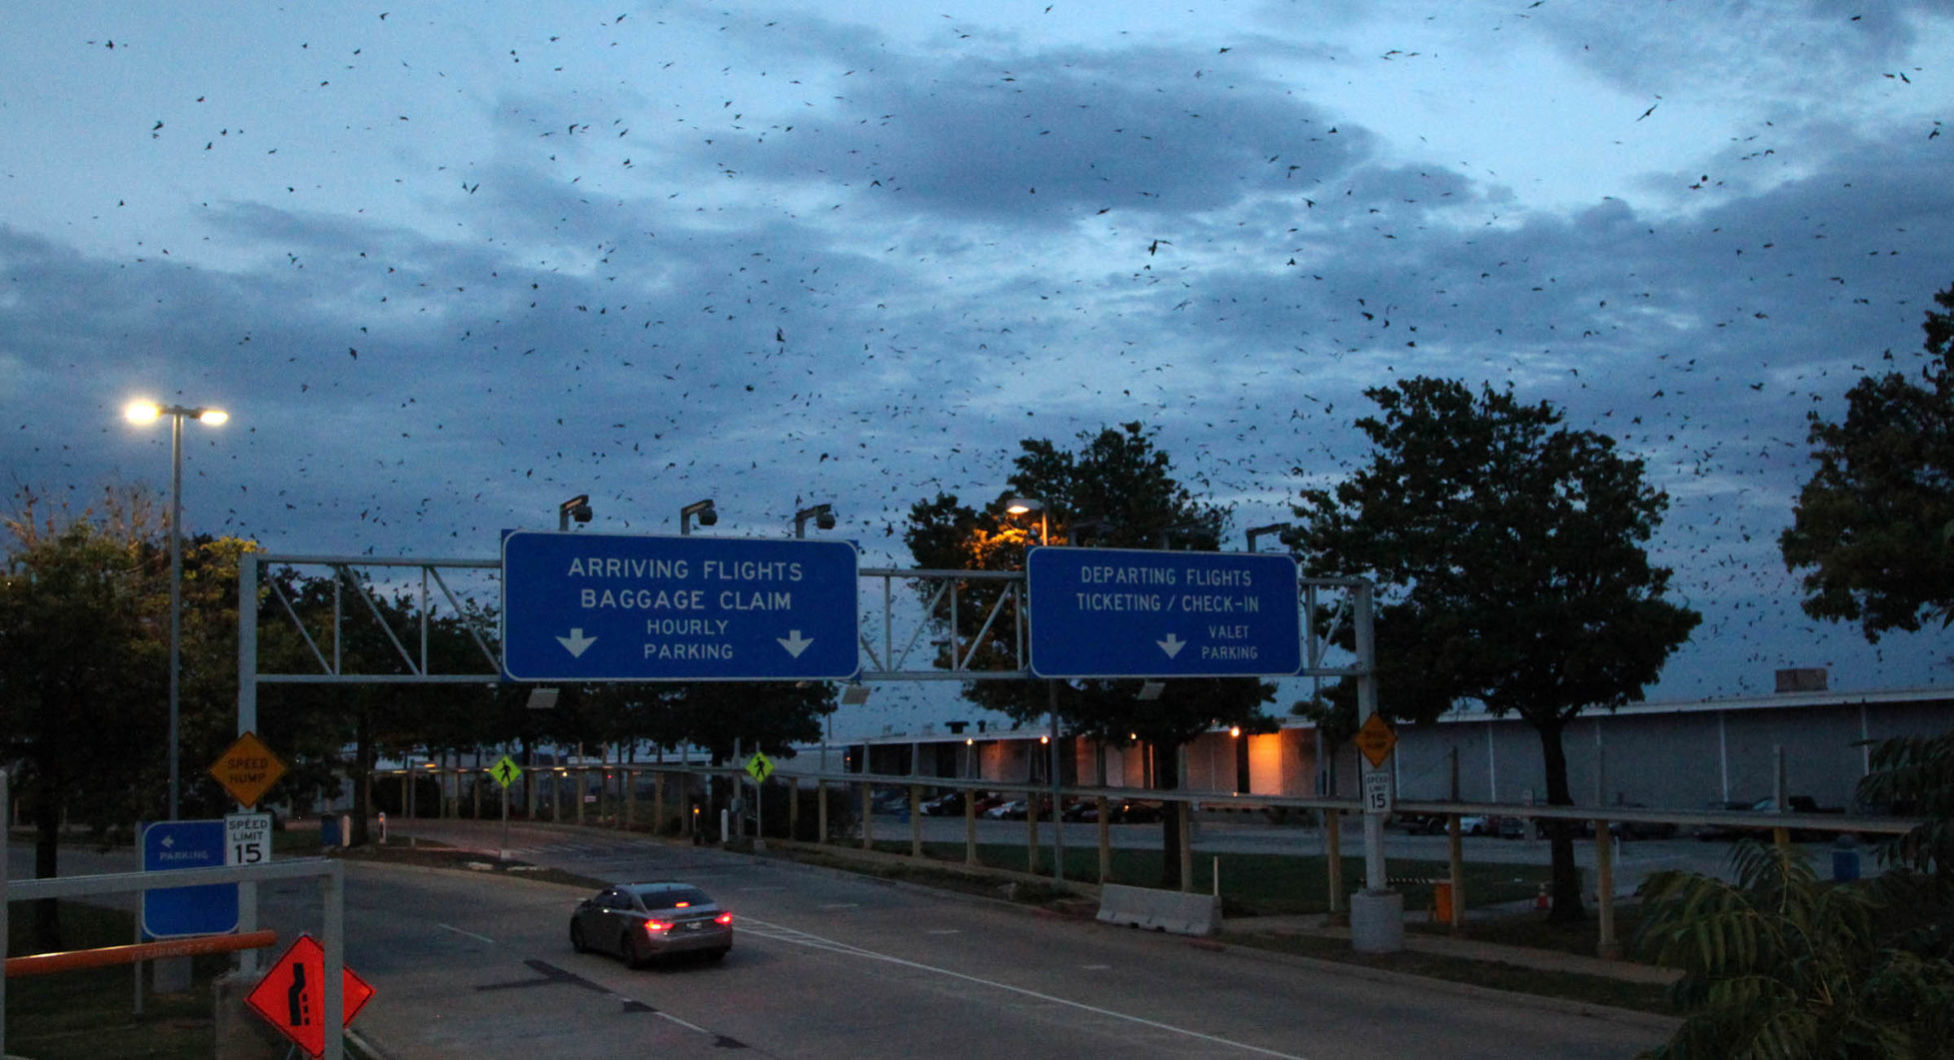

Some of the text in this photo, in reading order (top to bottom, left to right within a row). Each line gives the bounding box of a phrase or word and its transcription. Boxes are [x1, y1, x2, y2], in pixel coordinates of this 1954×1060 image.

[567, 558, 803, 582] ARRIVING FLIGHTS
[1081, 566, 1252, 586] DEPARTING FLIGHTS
[581, 589, 792, 611] BAGGAGE CLAIM
[1076, 593, 1161, 611] TICKETING
[1182, 596, 1259, 612] CHECK-IN
[647, 619, 729, 636] HOURLY
[1208, 625, 1250, 639] VALET
[644, 644, 734, 660] PARKING
[1202, 646, 1259, 660] PARKING
[227, 758, 268, 770] SPEED
[229, 772, 267, 784] HUMP
[1370, 793, 1386, 809] 15
[229, 819, 268, 830] SPEED
[233, 831, 263, 841] LIMIT
[159, 850, 208, 861] PARKING
[235, 843, 262, 864] 15
